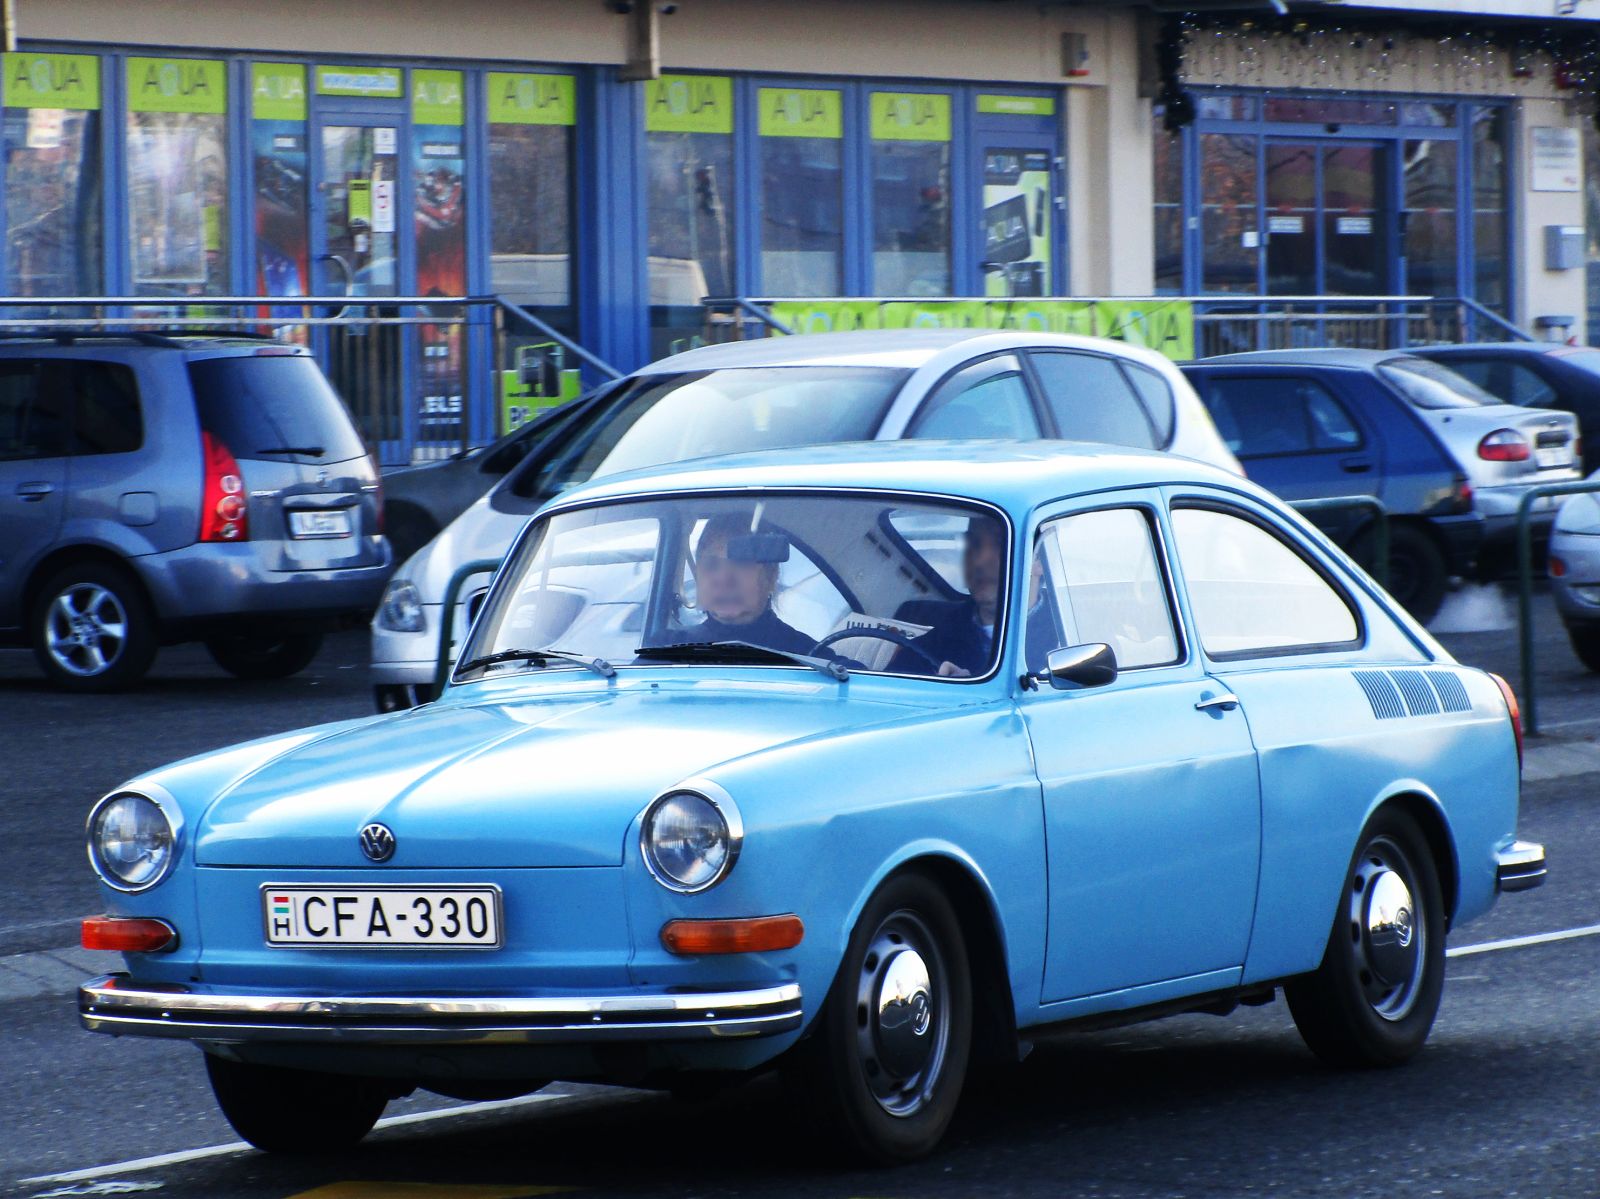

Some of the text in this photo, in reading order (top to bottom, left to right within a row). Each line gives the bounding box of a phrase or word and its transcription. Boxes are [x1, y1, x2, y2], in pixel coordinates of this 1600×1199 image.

[12, 58, 84, 93] AQUA
[141, 63, 211, 97] AQUA
[502, 79, 565, 110] AQUA
[652, 77, 717, 116] AQUA
[771, 92, 827, 124] AQUA
[884, 97, 940, 128] AQUA
[274, 896, 489, 938] H CFA-330
